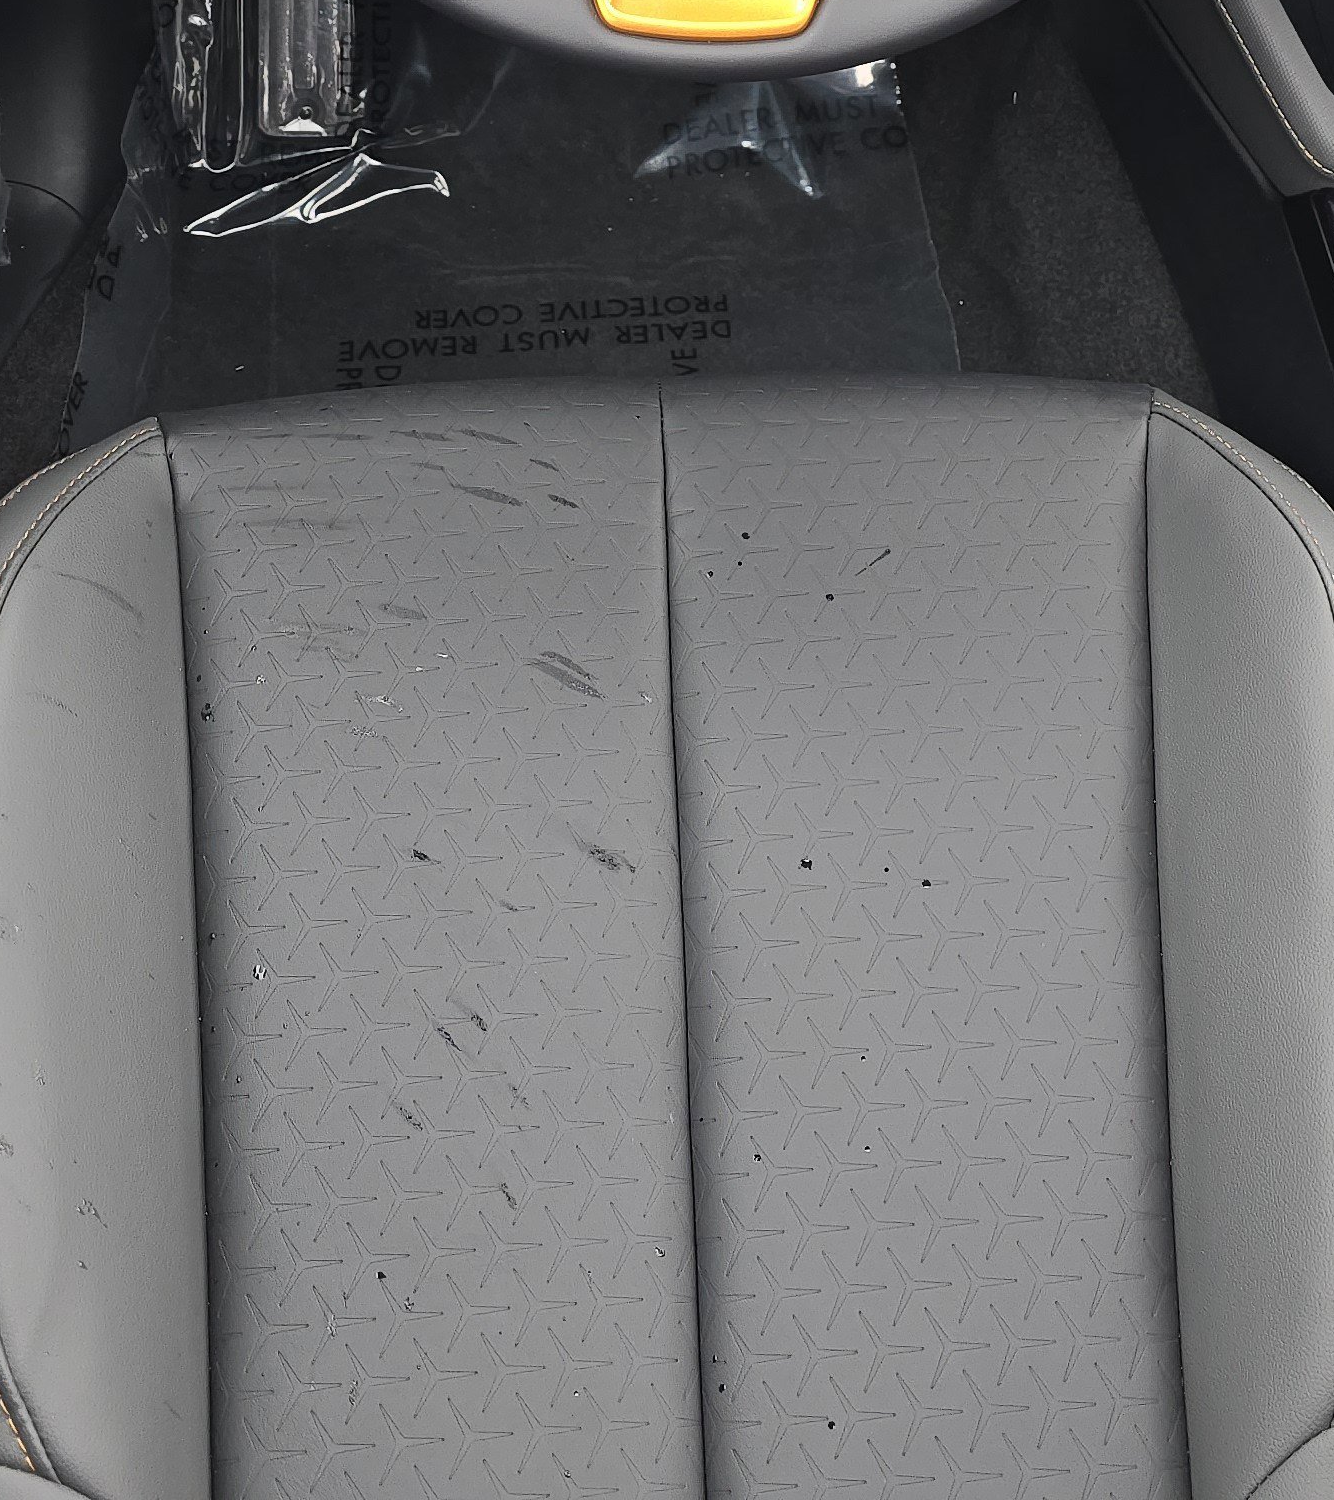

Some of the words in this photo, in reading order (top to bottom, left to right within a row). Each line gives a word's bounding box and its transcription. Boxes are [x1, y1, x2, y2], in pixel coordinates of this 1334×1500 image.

[660, 107, 775, 145] DEALER
[796, 94, 878, 124] MUST
[414, 303, 523, 331] COVER
[538, 295, 729, 324] PROTECTIVE
[499, 328, 591, 354] MUST
[615, 319, 732, 346] DEALER
[336, 335, 478, 364] REMOVE
[55, 371, 89, 458] OVER
